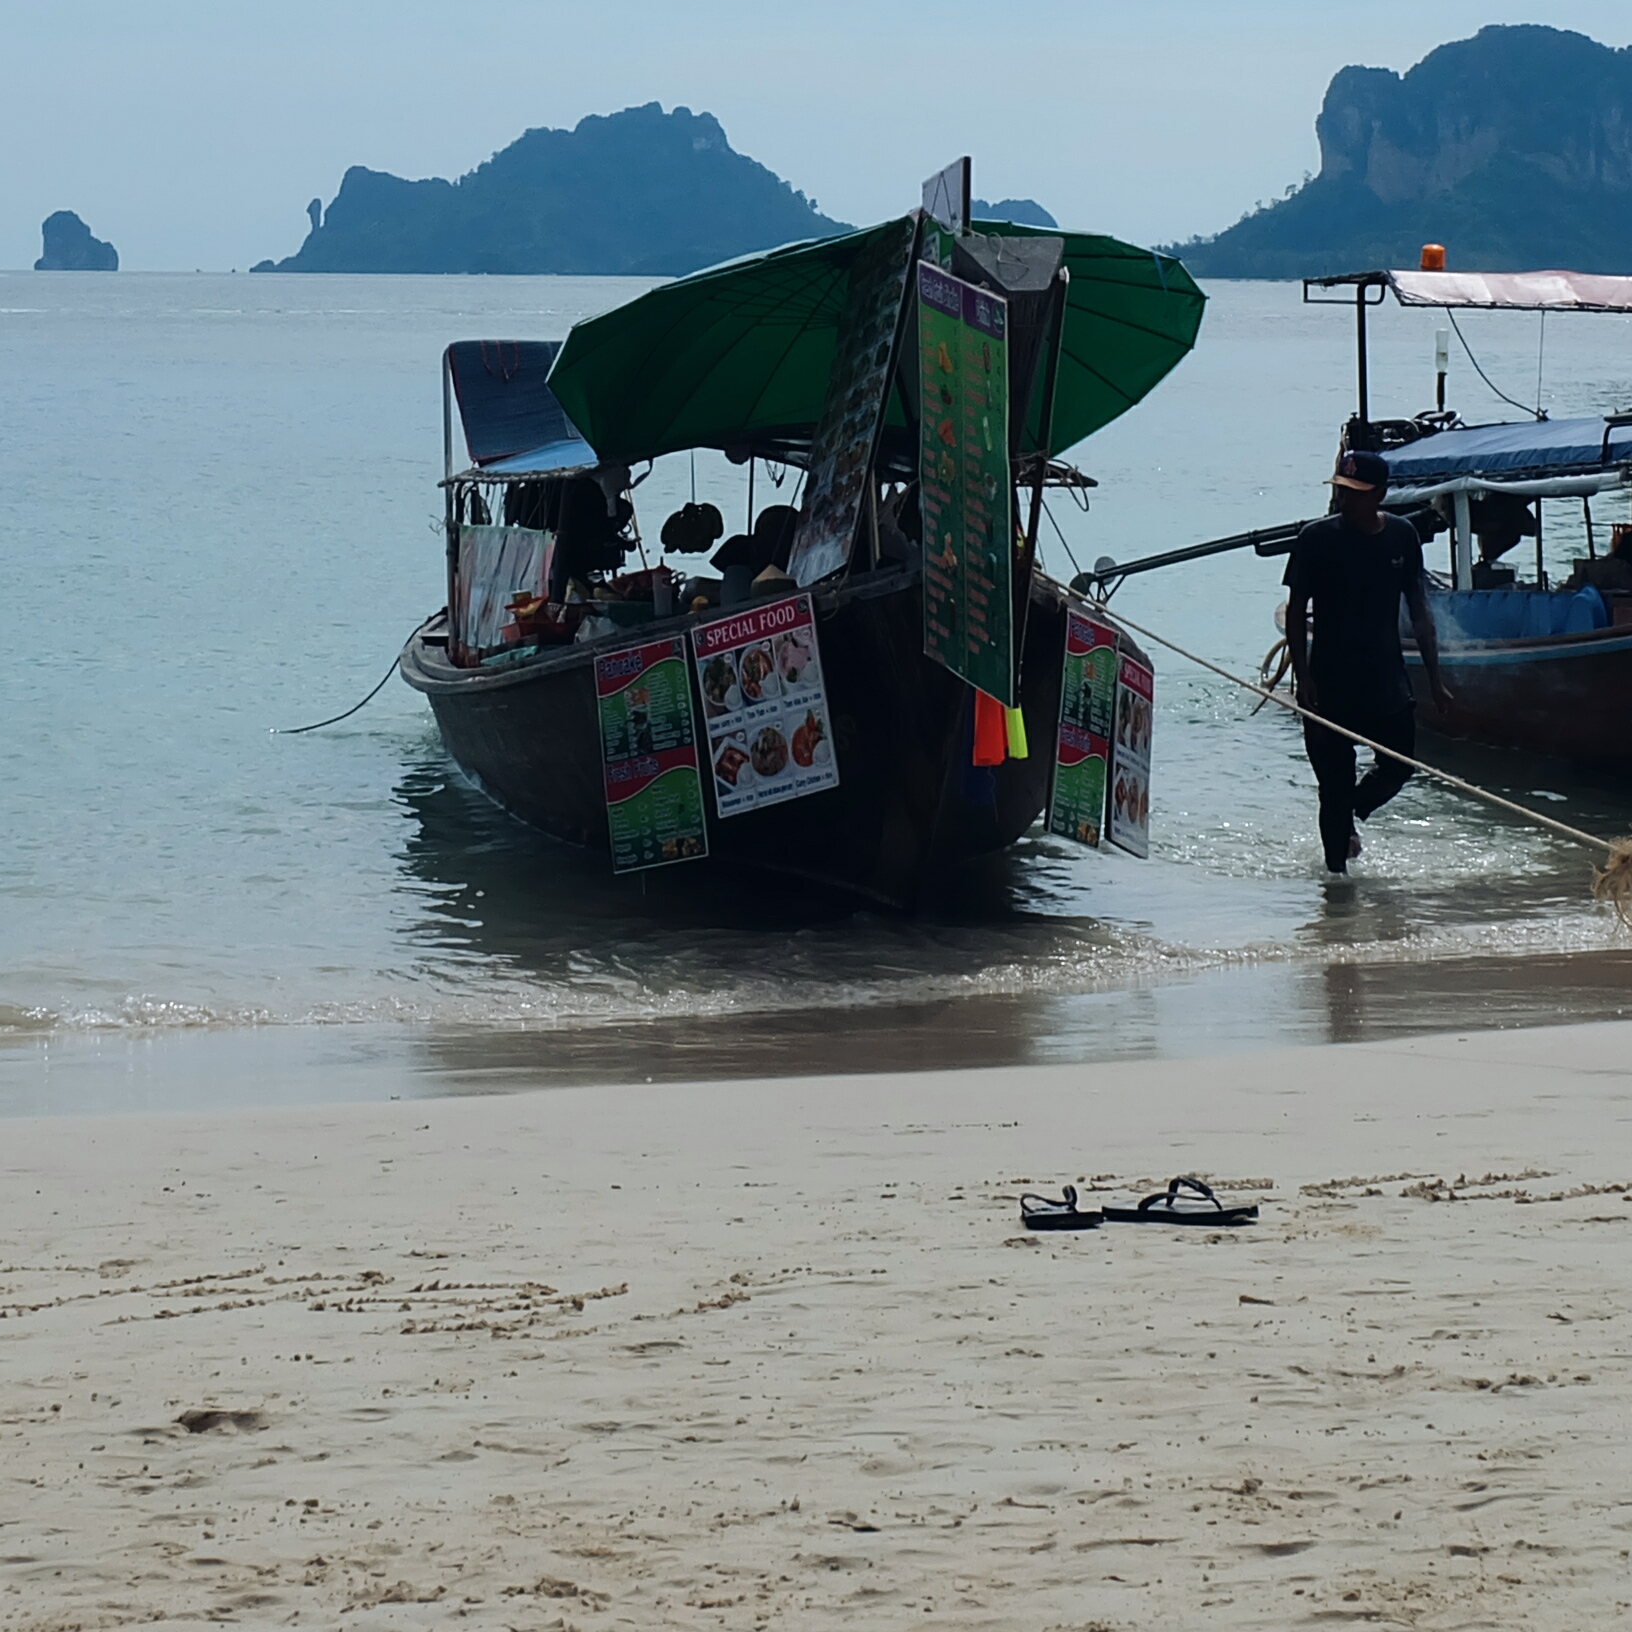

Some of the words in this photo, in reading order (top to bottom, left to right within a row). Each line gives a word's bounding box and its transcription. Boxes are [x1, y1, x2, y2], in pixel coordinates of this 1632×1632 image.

[706, 618, 757, 648] SPECIAL
[759, 605, 796, 631] FOOD
[599, 652, 642, 680] Pancake
